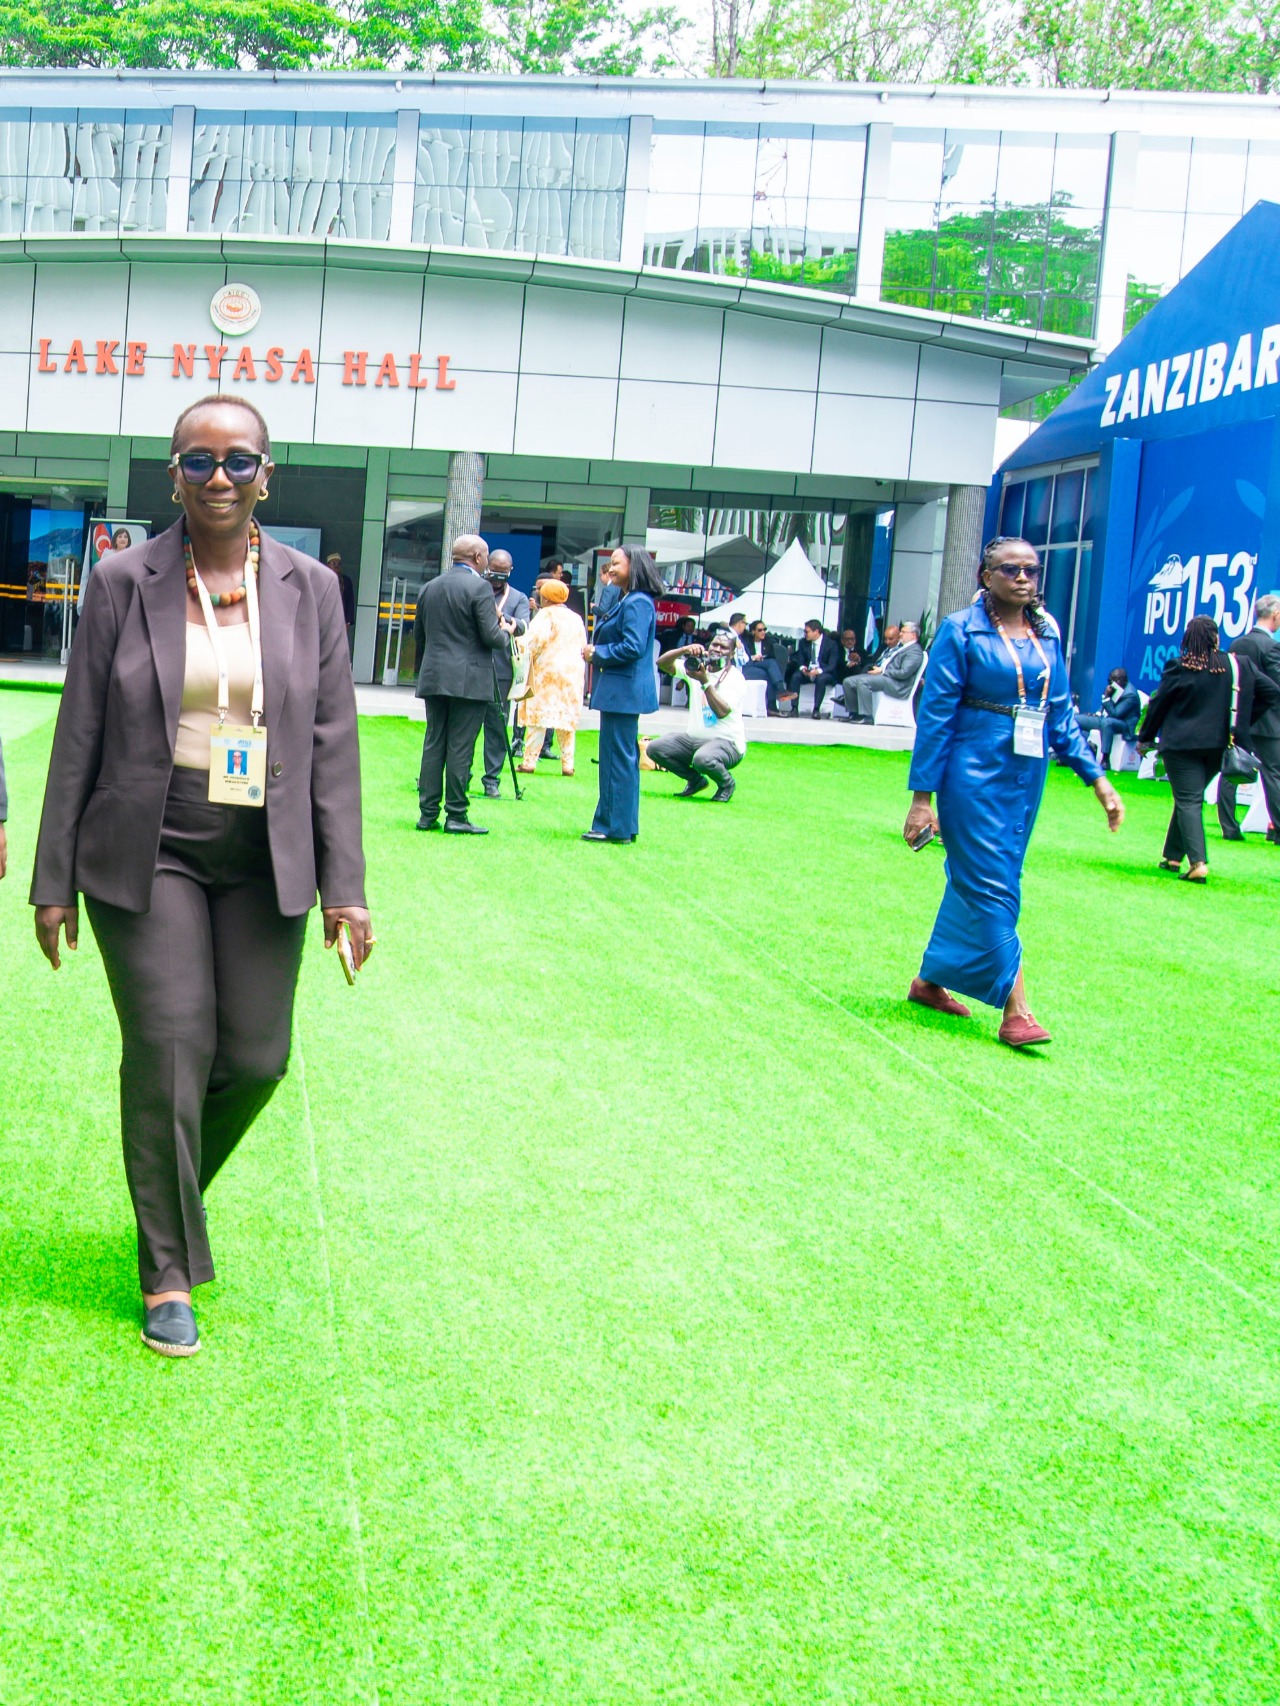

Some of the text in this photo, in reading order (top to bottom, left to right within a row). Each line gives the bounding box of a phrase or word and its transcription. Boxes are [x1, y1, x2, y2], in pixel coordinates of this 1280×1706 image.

[38, 339, 457, 389] LAKE NYASA HALL
[1100, 324, 1280, 428] ZANZIBAR
[1144, 591, 1182, 635] IPU
